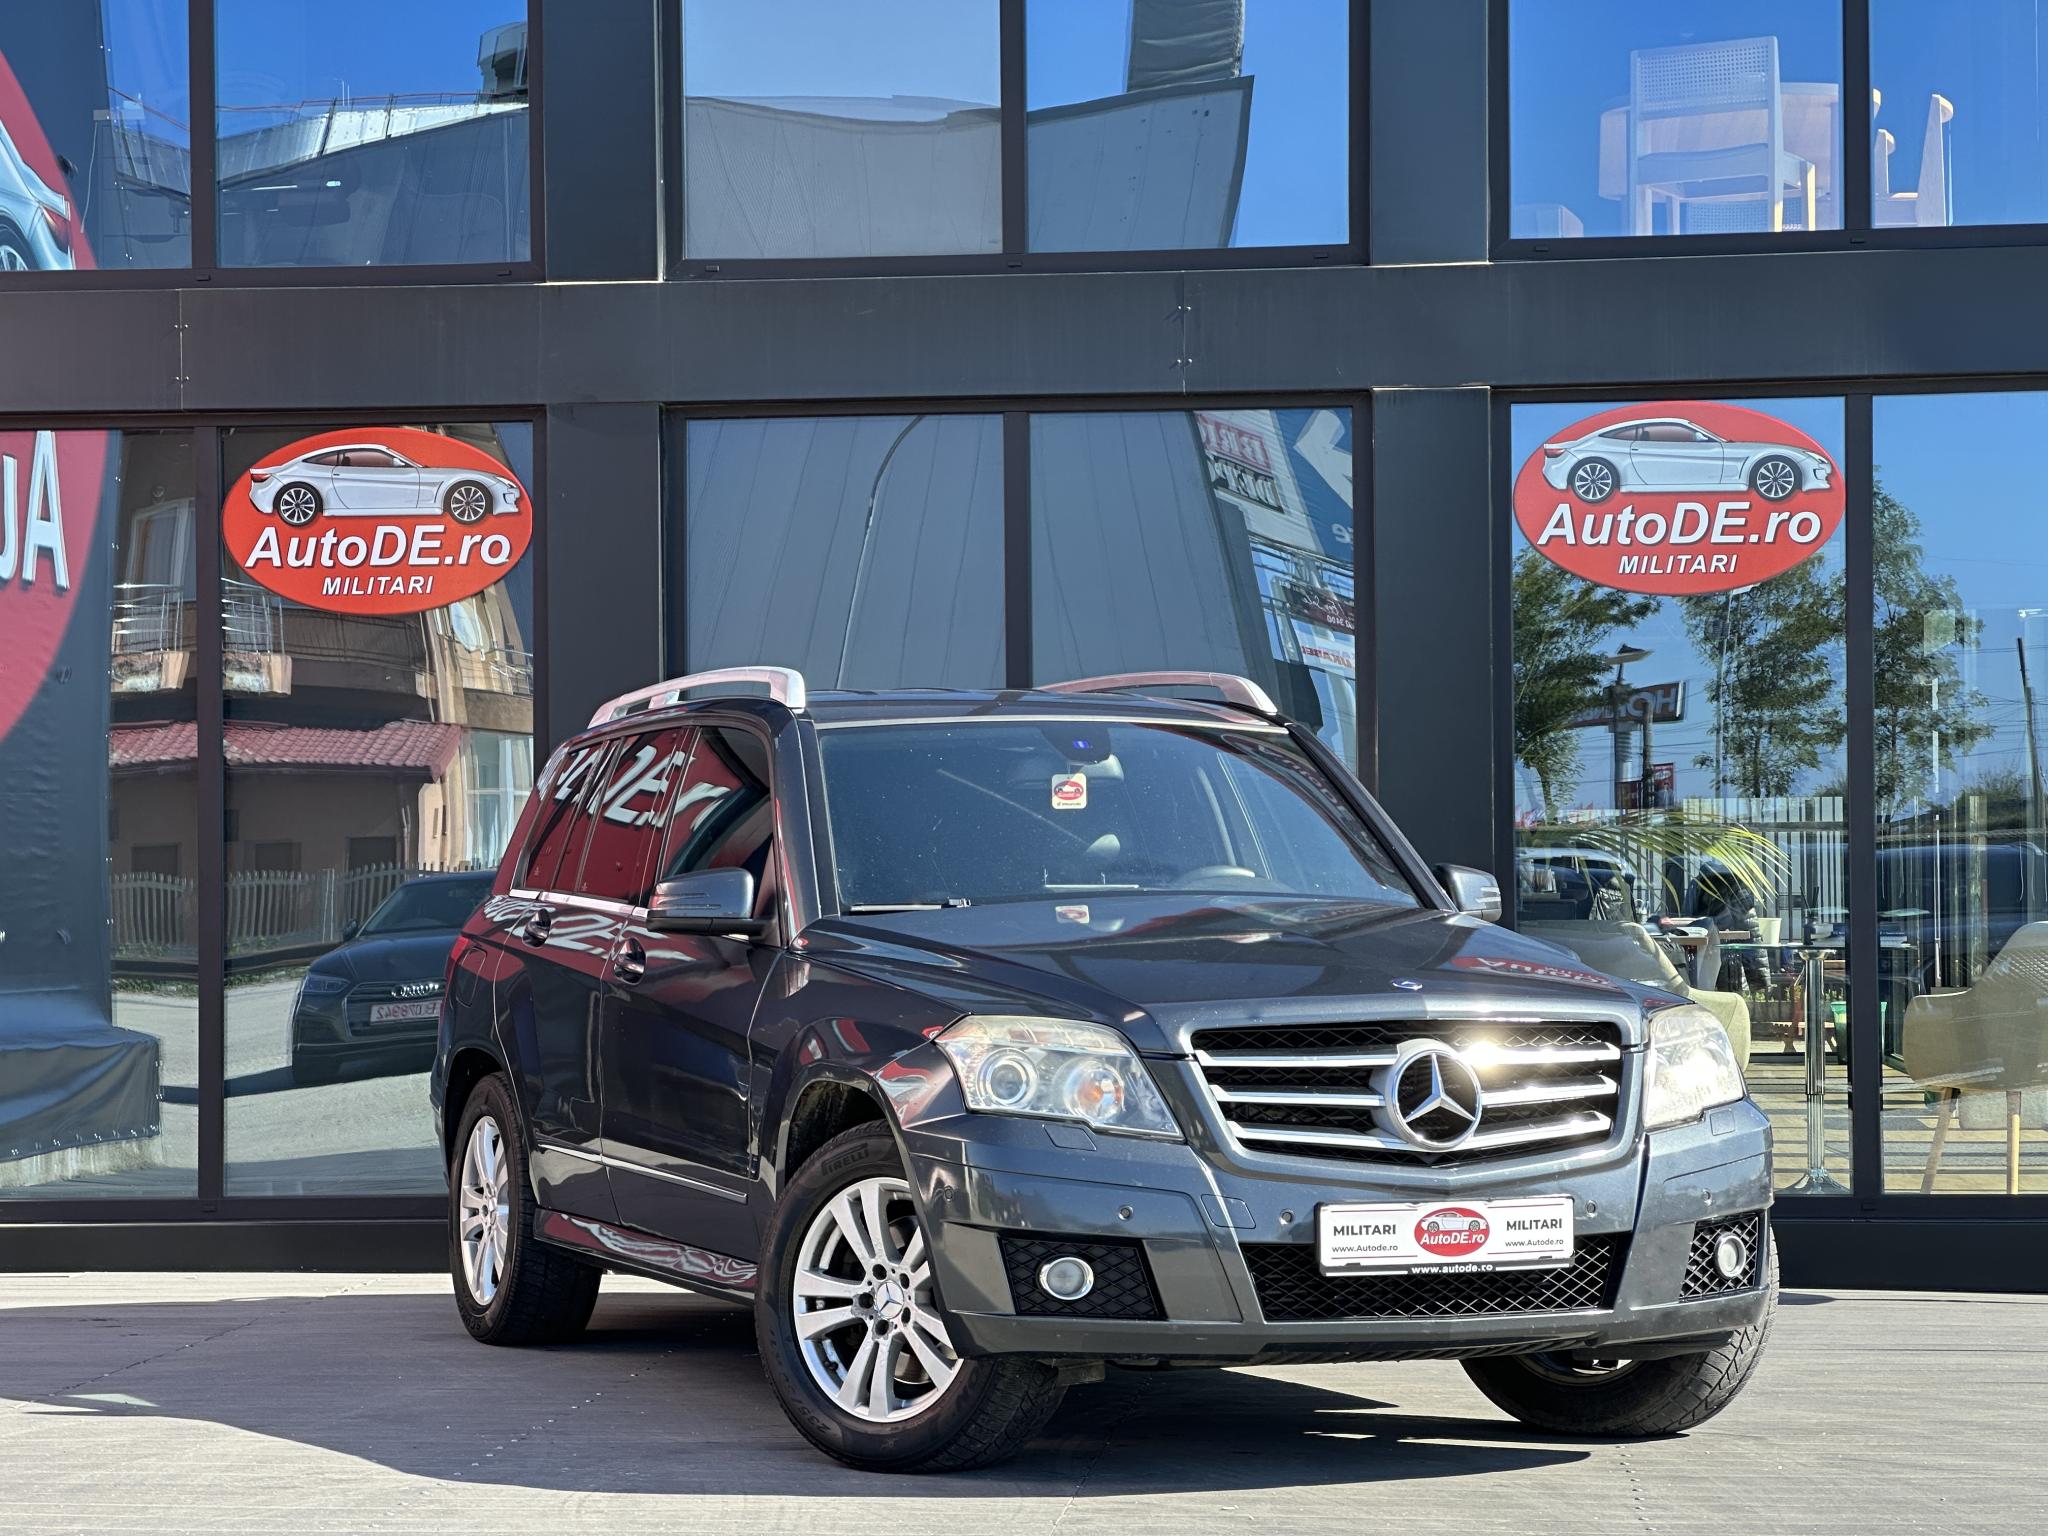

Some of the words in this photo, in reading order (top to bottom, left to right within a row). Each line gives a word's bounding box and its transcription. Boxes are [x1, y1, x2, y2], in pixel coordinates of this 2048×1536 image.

[1537, 500, 1821, 546] AutoDE.ro
[245, 524, 511, 569] AutoDE.ro
[1618, 553, 1738, 574] MILITARI
[321, 575, 434, 596] MILITARI
[1333, 1223, 1397, 1236] MILITARI
[1506, 1218, 1563, 1231] MILITARI
[1420, 1231, 1486, 1246] AutoDE.ro
[1505, 1238, 1564, 1248] www.Autode.ro
[1332, 1243, 1398, 1253] www.Autode.ro
[1411, 1262, 1494, 1275] www.autode.ro
